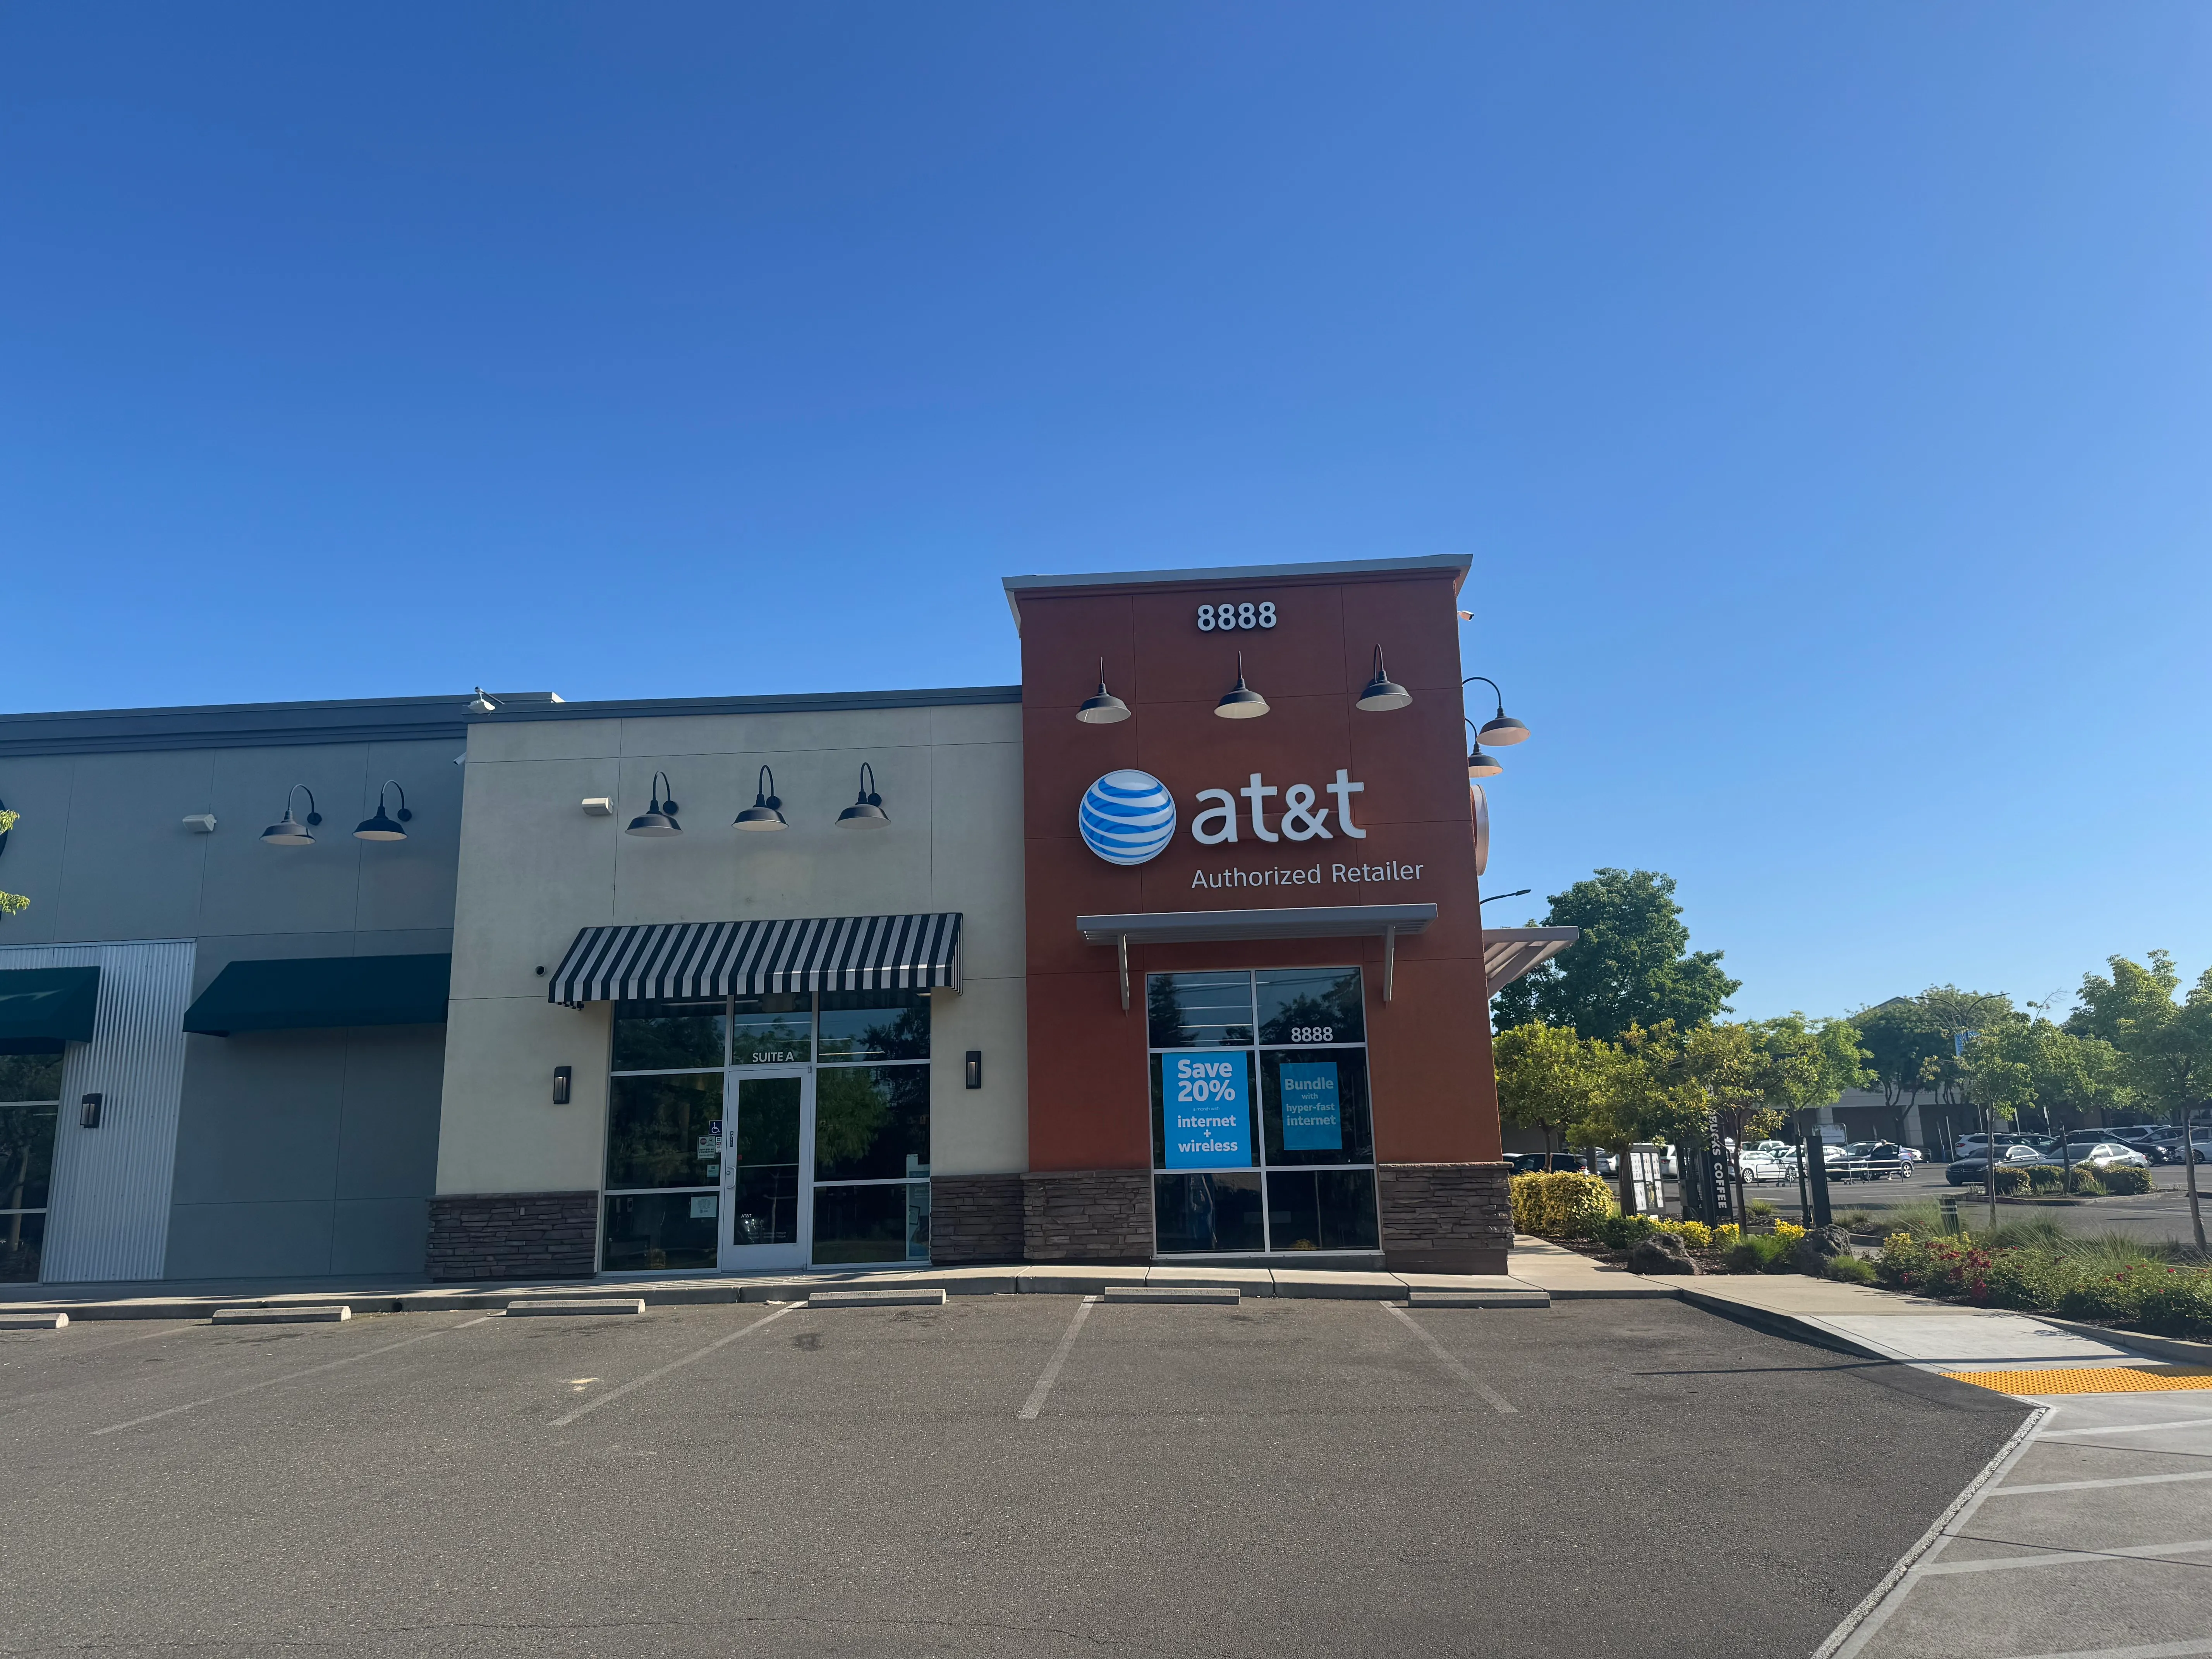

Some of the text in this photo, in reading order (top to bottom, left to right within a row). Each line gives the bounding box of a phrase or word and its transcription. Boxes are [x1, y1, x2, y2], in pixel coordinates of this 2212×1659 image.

[1197, 601, 1277, 632] 8888
[1191, 768, 1367, 845] at&t
[1191, 860, 1424, 889] Authorized Retailer
[1291, 1027, 1333, 1042] 8888
[752, 1051, 795, 1063] SUITE A
[1178, 1059, 1232, 1078] Save
[1178, 1079, 1235, 1102] 20%
[1285, 1078, 1334, 1090] Bundle
[1286, 1103, 1335, 1113] hyper-fast
[1178, 1115, 1237, 1128] internet
[1286, 1115, 1336, 1126] internet
[1203, 1129, 1211, 1138] +
[1178, 1139, 1238, 1152] wireless
[1714, 1162, 1727, 1209] COFFEE
